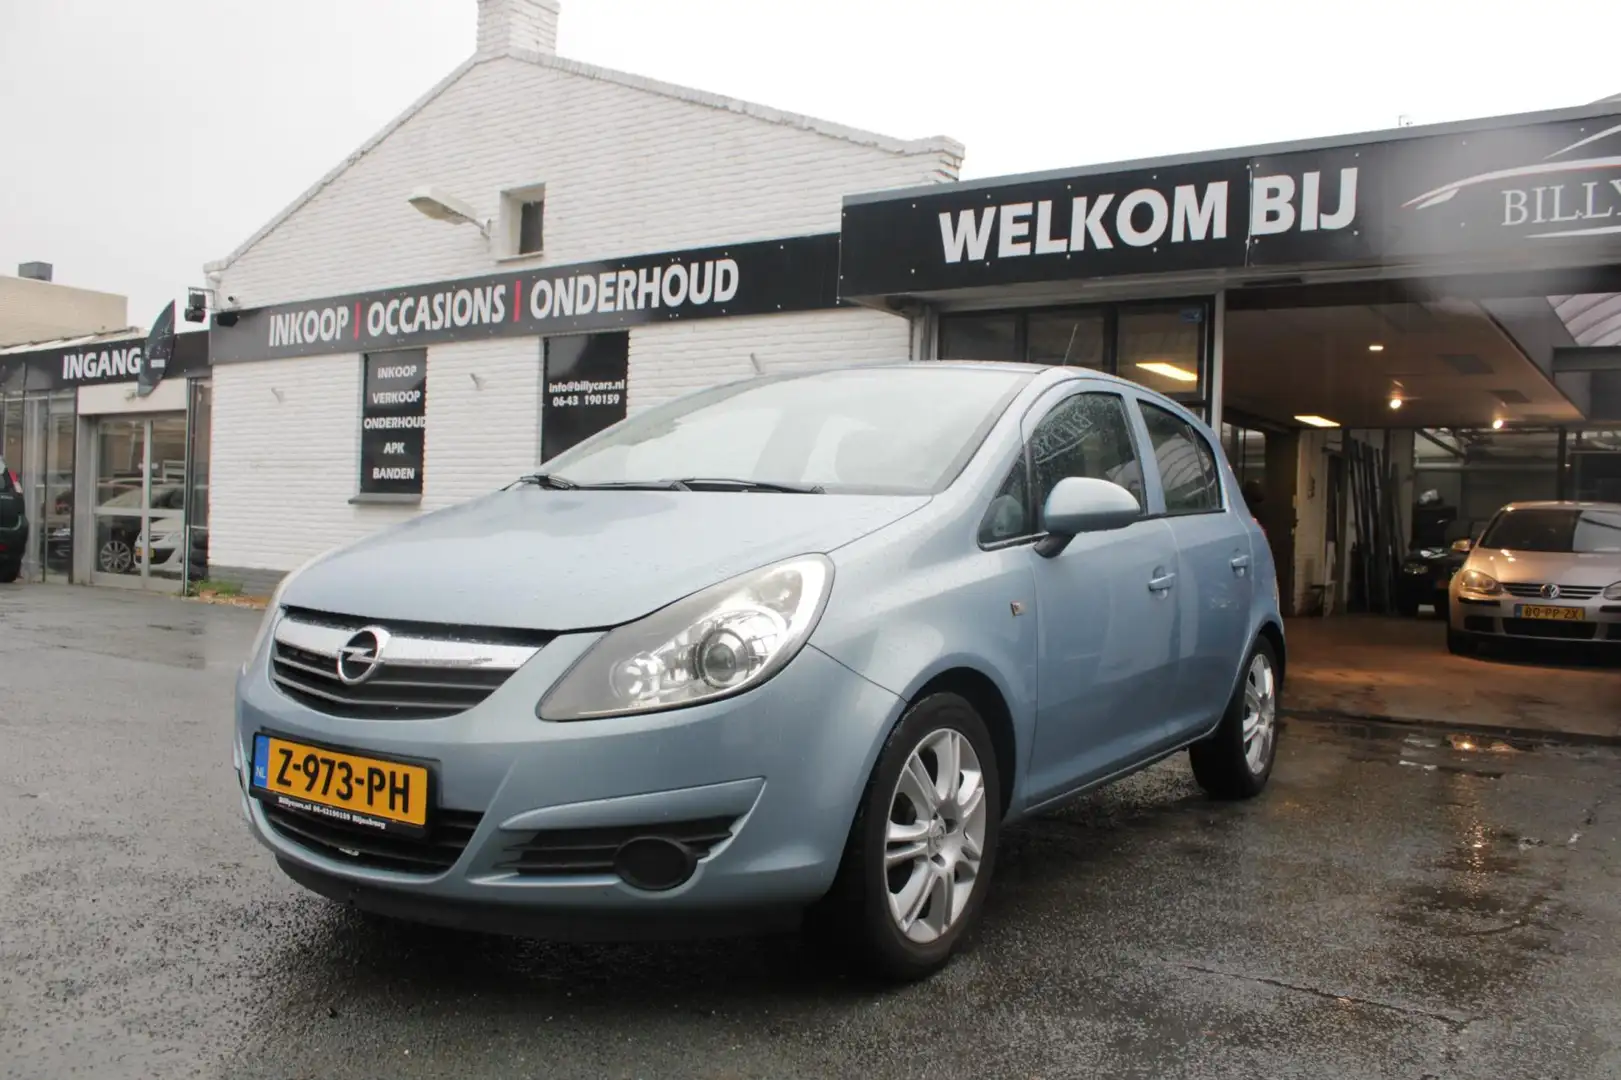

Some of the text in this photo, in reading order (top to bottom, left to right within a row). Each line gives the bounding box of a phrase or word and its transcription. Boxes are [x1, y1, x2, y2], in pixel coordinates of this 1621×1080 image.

[939, 166, 1358, 264] WELKOM BIJ
[268, 258, 740, 348] INKOOP OCCASIONS ONDERHOUD
[63, 347, 142, 380] INGANG
[377, 365, 417, 379] INKOOP
[372, 390, 421, 404] VERKOOP
[584, 394, 620, 406] 190159
[363, 415, 427, 430] ONDERHOUD
[383, 441, 406, 454] APK
[372, 467, 415, 480] BANDEN
[276, 748, 410, 814] Z-973-PH
